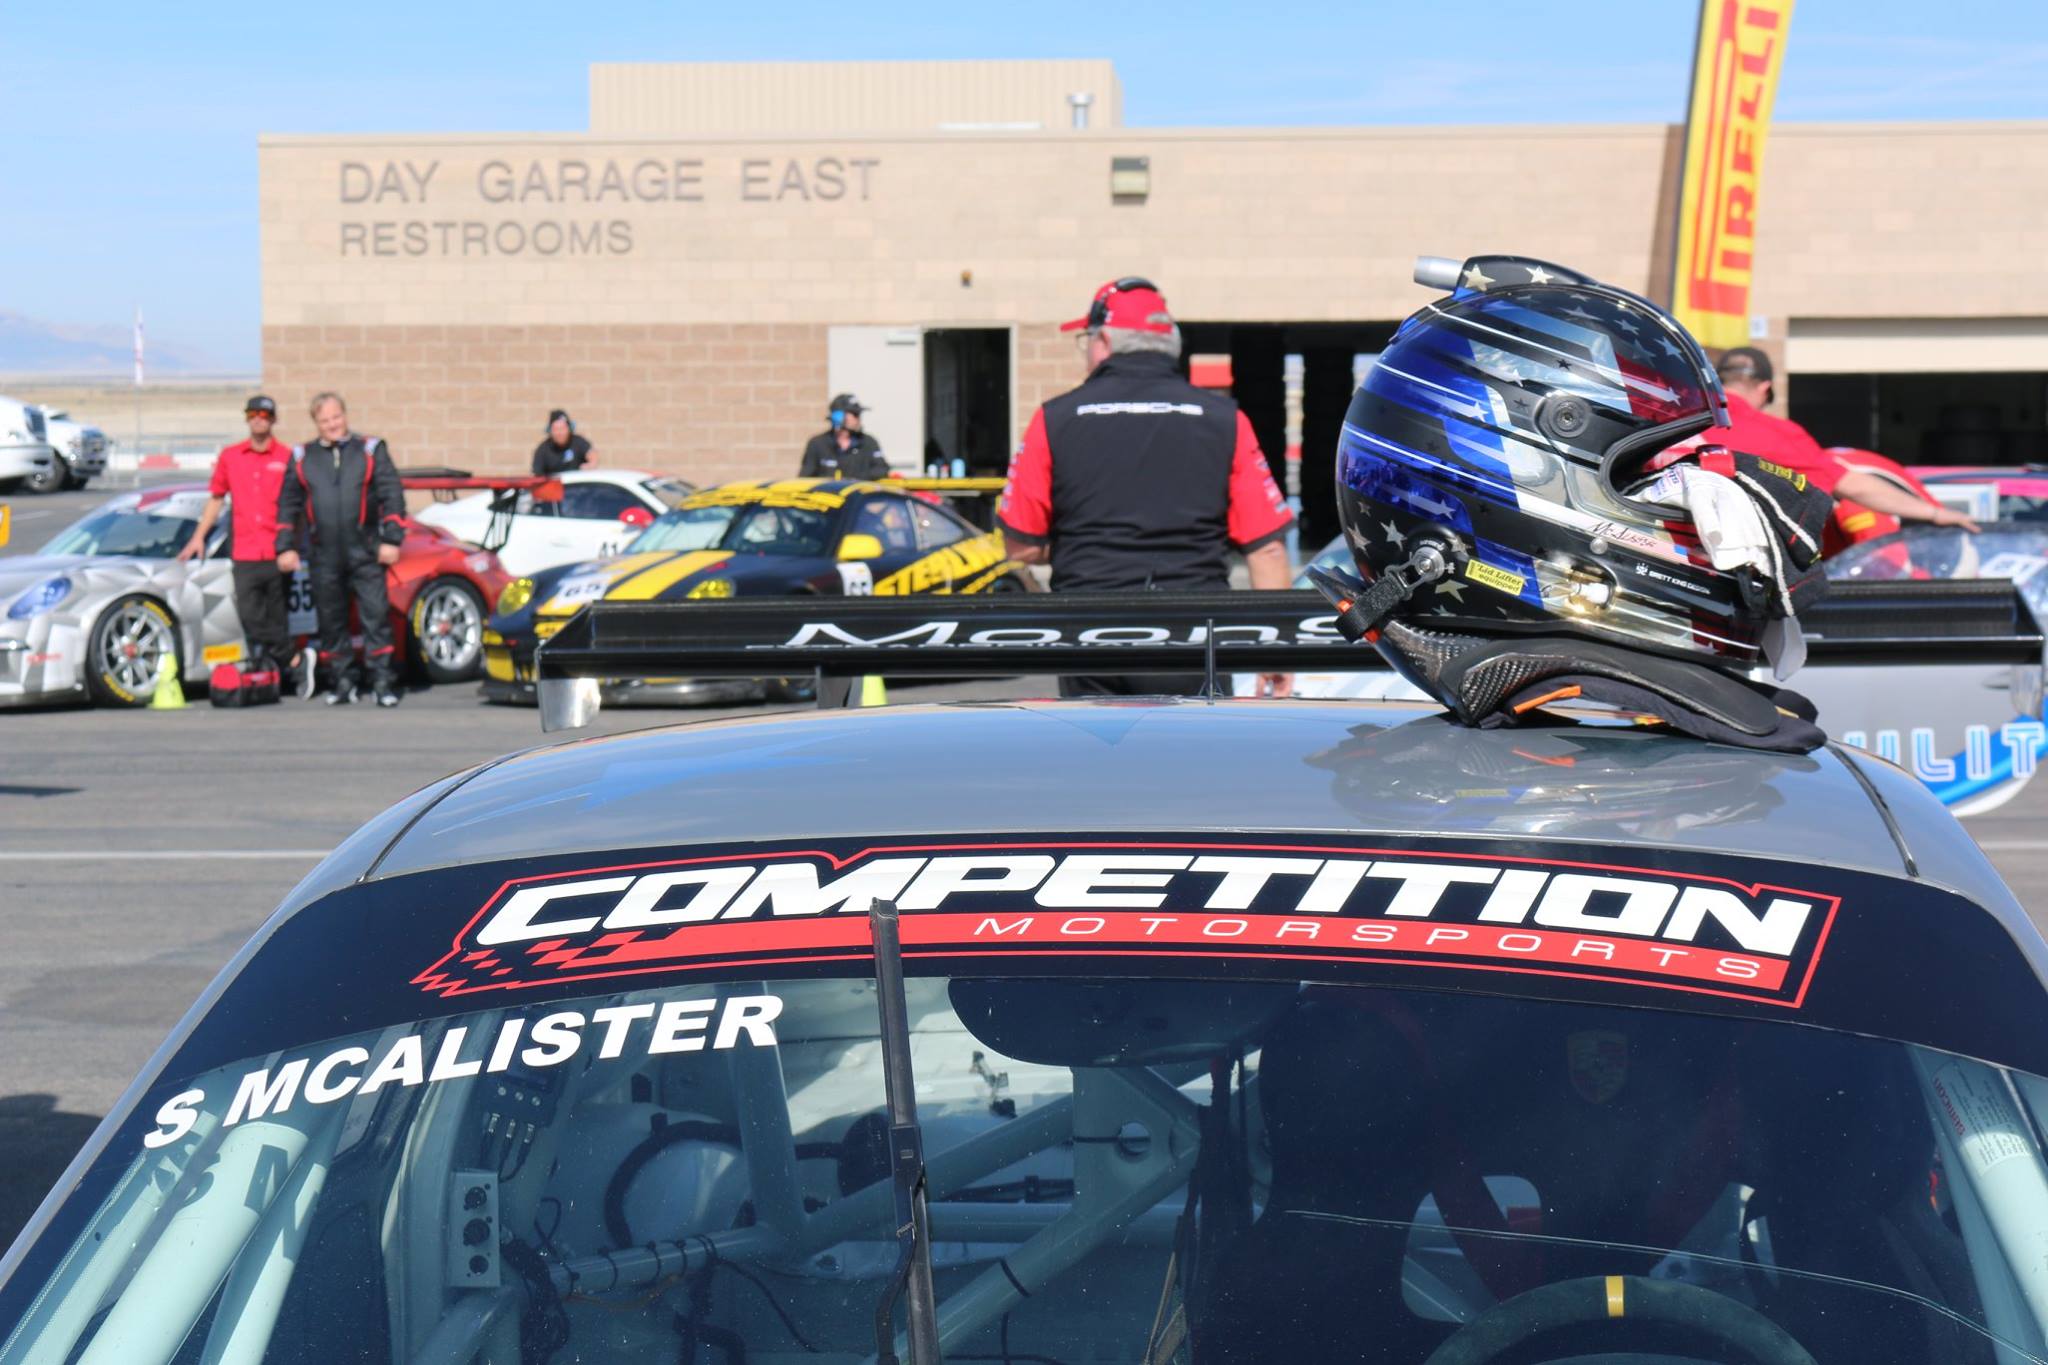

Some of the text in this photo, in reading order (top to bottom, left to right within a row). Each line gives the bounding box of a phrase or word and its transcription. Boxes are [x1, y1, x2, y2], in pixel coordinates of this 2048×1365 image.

[340, 157, 881, 204] DAY GARAGE EAST
[1689, 0, 1781, 316] PIRELLI
[340, 220, 633, 257] RESTROOMS
[477, 855, 1813, 956] COMPETITION
[974, 915, 1779, 981] MOTORSPORTS
[144, 994, 785, 1149] S MCALISTER
